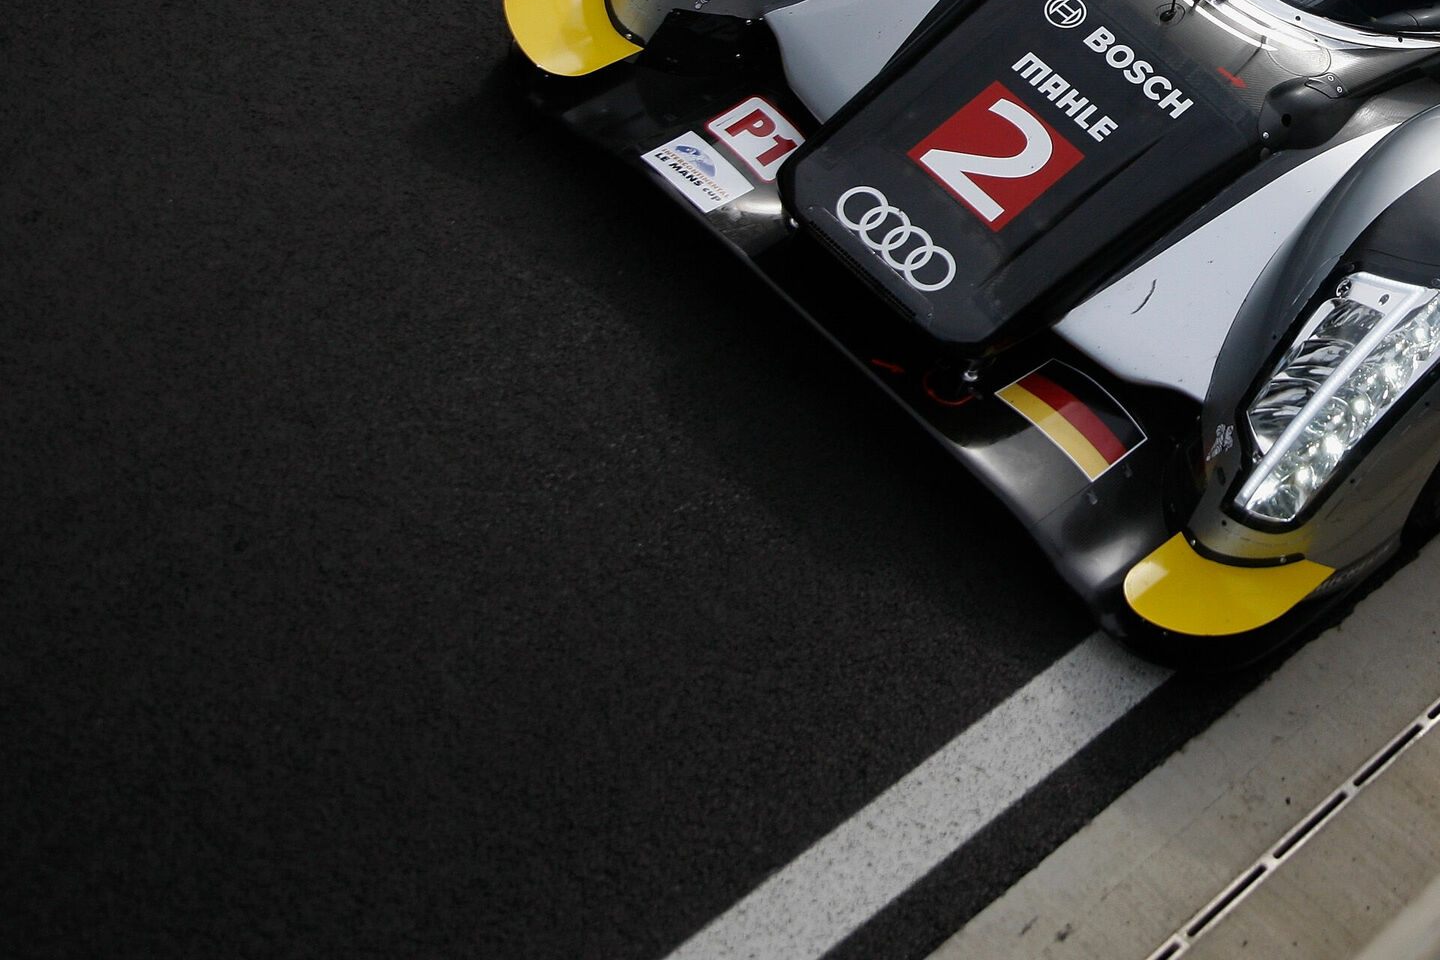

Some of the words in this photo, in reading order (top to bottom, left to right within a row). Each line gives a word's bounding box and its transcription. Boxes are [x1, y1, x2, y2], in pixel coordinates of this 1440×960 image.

[1011, 52, 1118, 142] MAHLE
[1083, 26, 1194, 119] BOSCH
[654, 152, 670, 162] LE
[668, 162, 704, 186] MANS
[724, 108, 798, 167] P1
[919, 97, 1054, 223] 2
